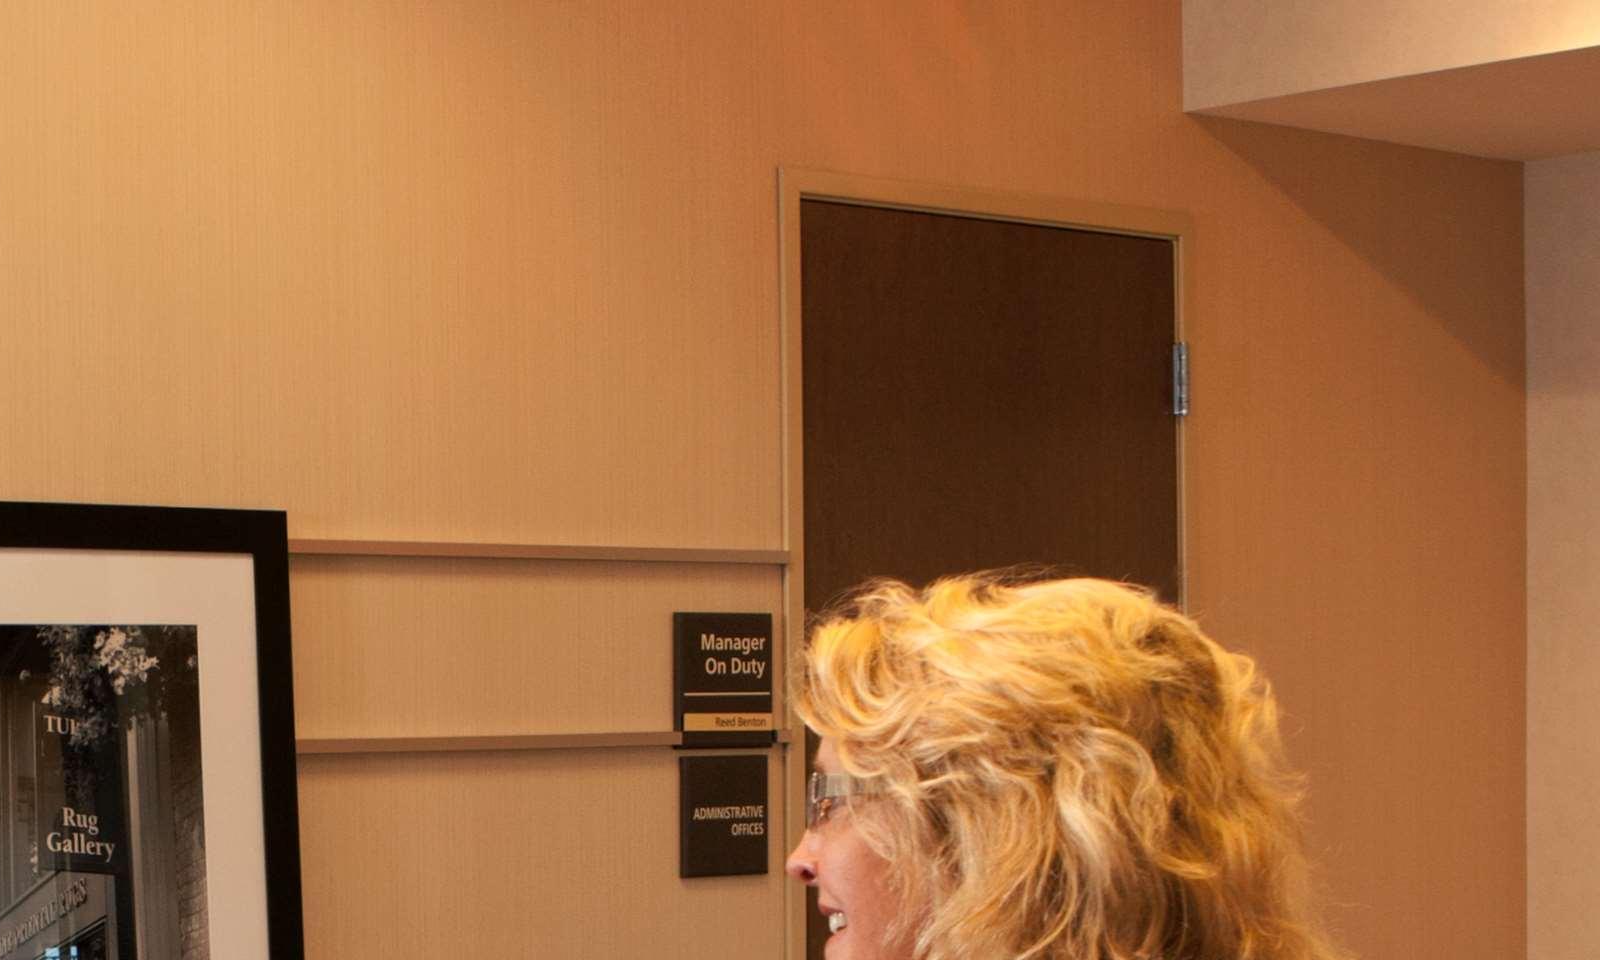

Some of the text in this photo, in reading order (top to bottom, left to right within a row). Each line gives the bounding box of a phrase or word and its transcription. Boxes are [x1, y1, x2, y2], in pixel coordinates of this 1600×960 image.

[701, 633, 766, 655] Manager
[705, 657, 766, 679] On Duty
[62, 807, 99, 835] Rug
[693, 806, 764, 820] ADMINISTRATIVE
[731, 822, 764, 836] OFFICES
[46, 832, 115, 862] Gallery
